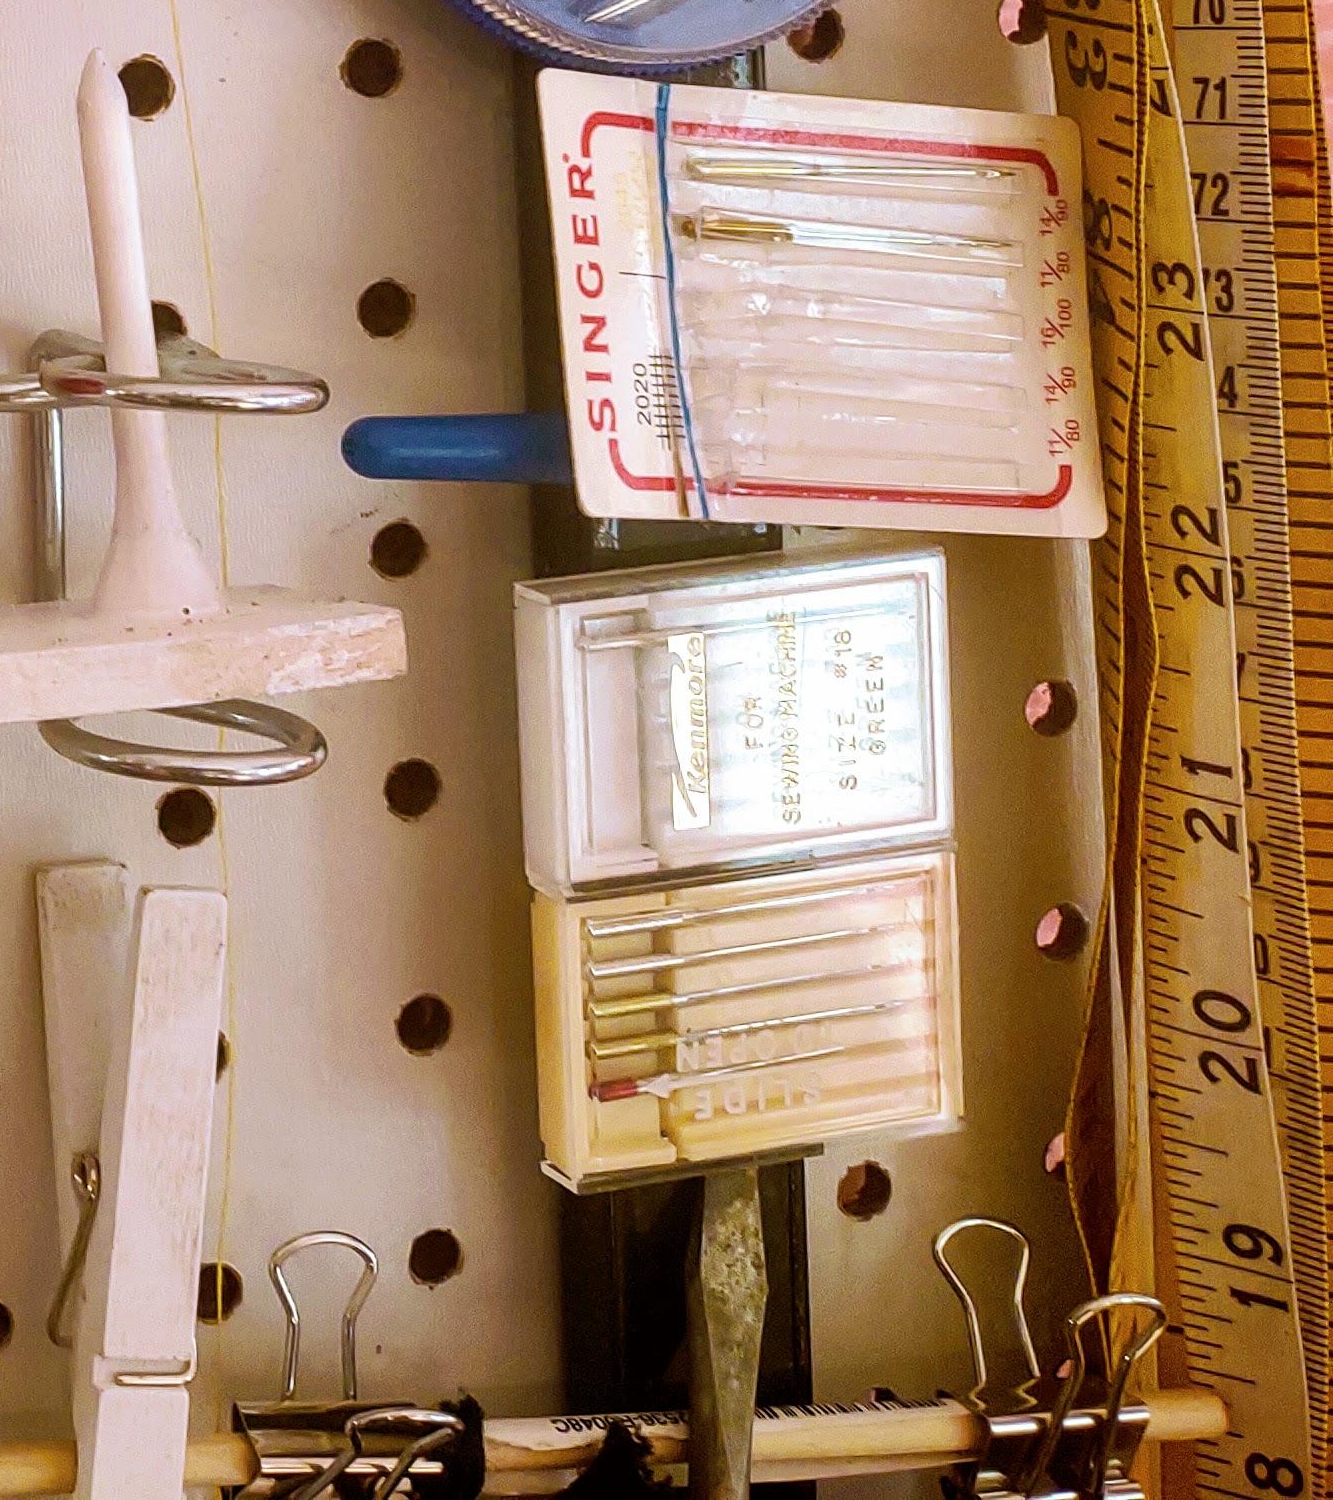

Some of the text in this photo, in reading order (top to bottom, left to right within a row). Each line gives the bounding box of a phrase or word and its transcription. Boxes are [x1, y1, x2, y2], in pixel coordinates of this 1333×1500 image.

[1193, 76, 1227, 120] 71
[1191, 172, 1229, 217] 72
[569, 160, 617, 433] SINGER
[1151, 261, 1204, 361] 23
[633, 362, 653, 427] 2020
[1171, 504, 1225, 607] 22
[686, 636, 707, 794] Kenmore
[742, 696, 764, 751] FOR
[773, 611, 801, 825] SEWING MACHINE
[835, 712, 857, 790] SIZE
[865, 654, 886, 756] GREEN
[1180, 754, 1240, 853] 21
[1193, 989, 1261, 1094] 20
[1222, 1223, 1290, 1313] 19
